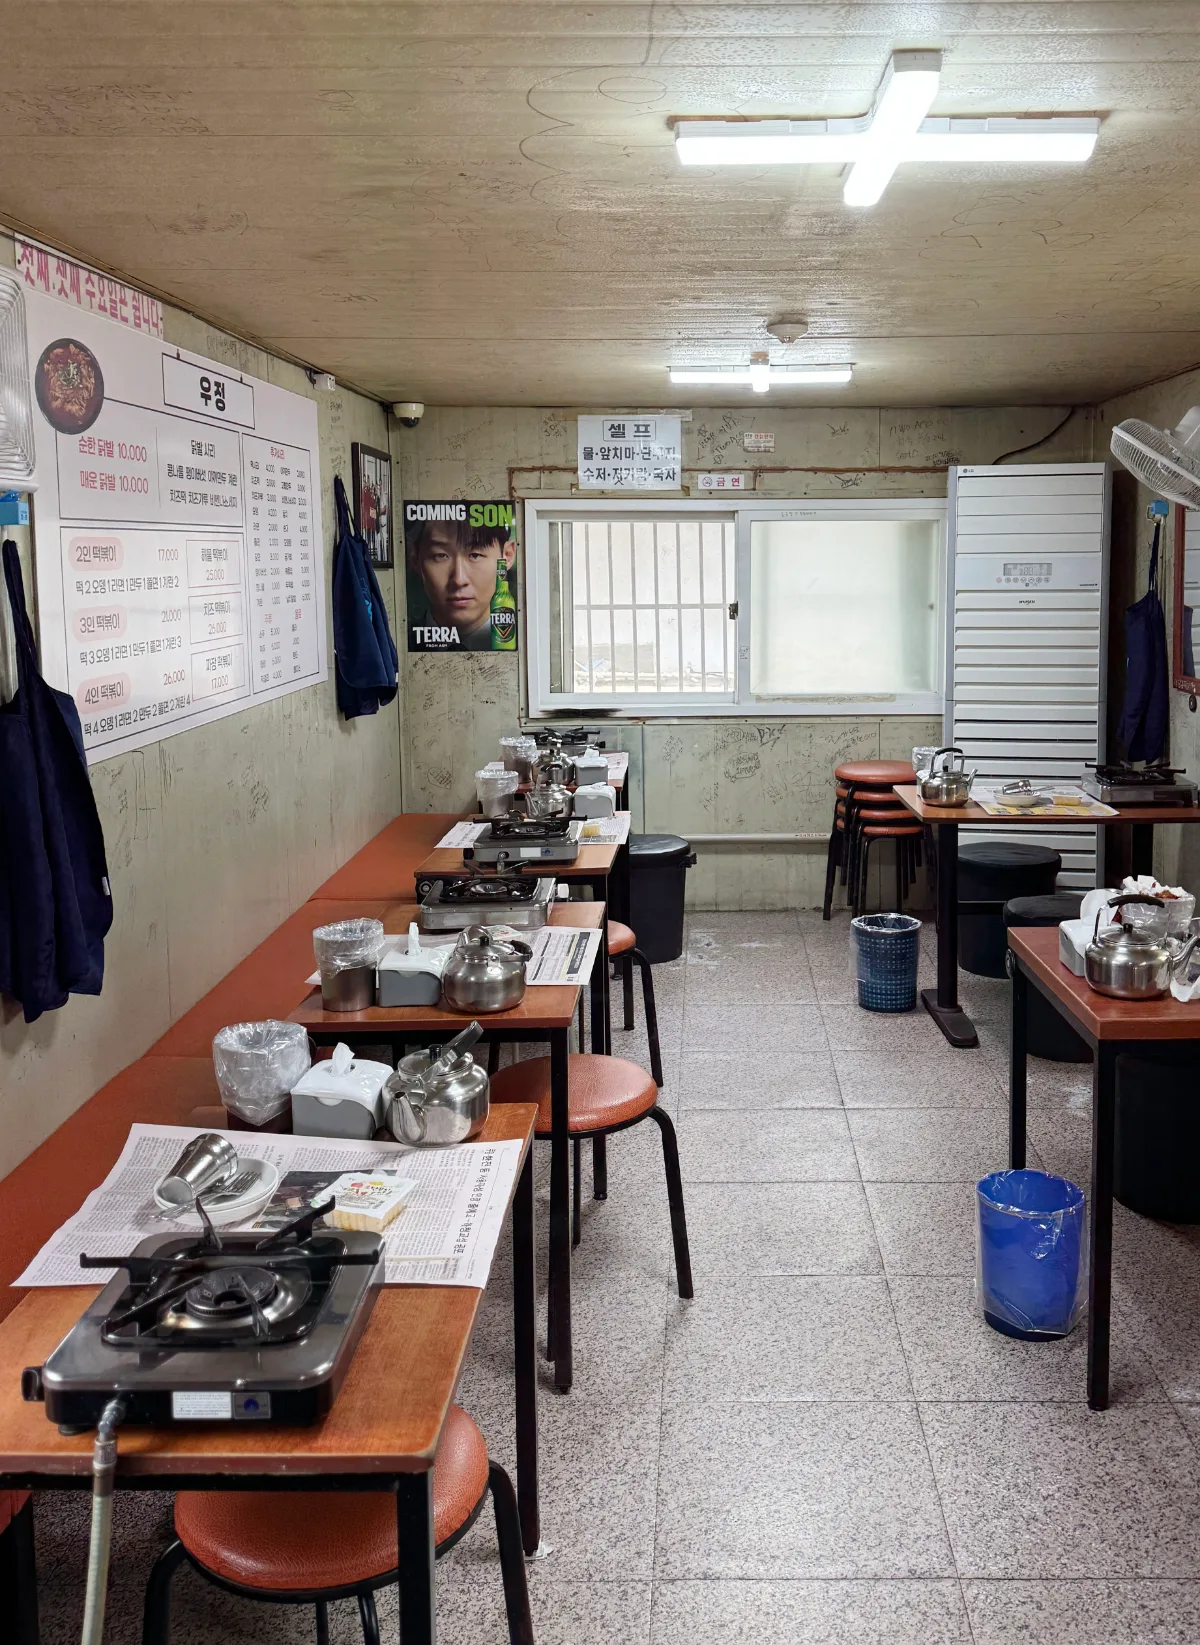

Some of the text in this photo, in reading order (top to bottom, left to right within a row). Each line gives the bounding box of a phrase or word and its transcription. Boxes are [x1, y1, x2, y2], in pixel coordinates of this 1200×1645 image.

[85, 271, 129, 323] 수요일은
[131, 289, 160, 337] 쉽니다
[199, 376, 226, 412] 우정
[79, 435, 95, 455] 순한
[97, 438, 114, 459] 닭발
[204, 442, 216, 458] 사리
[80, 470, 98, 490] 매운
[99, 472, 116, 491] 닭발
[406, 504, 467, 521] COMING
[75, 545, 117, 563] 2인 떡볶이
[75, 580, 84, 595] 떡
[85, 580, 91, 594] 2
[92, 579, 106, 594] 오뎅
[111, 578, 125, 592] 라면
[129, 577, 142, 591] 만두
[146, 576, 158, 590] 쫄면
[79, 613, 120, 634] 3인 떡볶이
[491, 613, 515, 625] TERRA
[412, 626, 460, 644] TERRA
[80, 651, 88, 666] 떡
[89, 650, 95, 665] 3
[96, 647, 110, 663] 오뎅
[115, 645, 128, 660] 라면
[133, 642, 146, 657] 만두
[150, 640, 162, 654] 쫄면
[84, 680, 124, 705] 4인 떡볶이
[84, 723, 92, 737] 떡
[93, 721, 99, 734] 4
[100, 716, 114, 732] 오뎅
[118, 711, 132, 727] 라면
[132, 710, 138, 722] 2
[139, 706, 152, 721] 만두
[152, 704, 157, 717] 2
[158, 702, 169, 716] 쫄면
[170, 699, 175, 711] 2
[187, 694, 191, 706] 4
